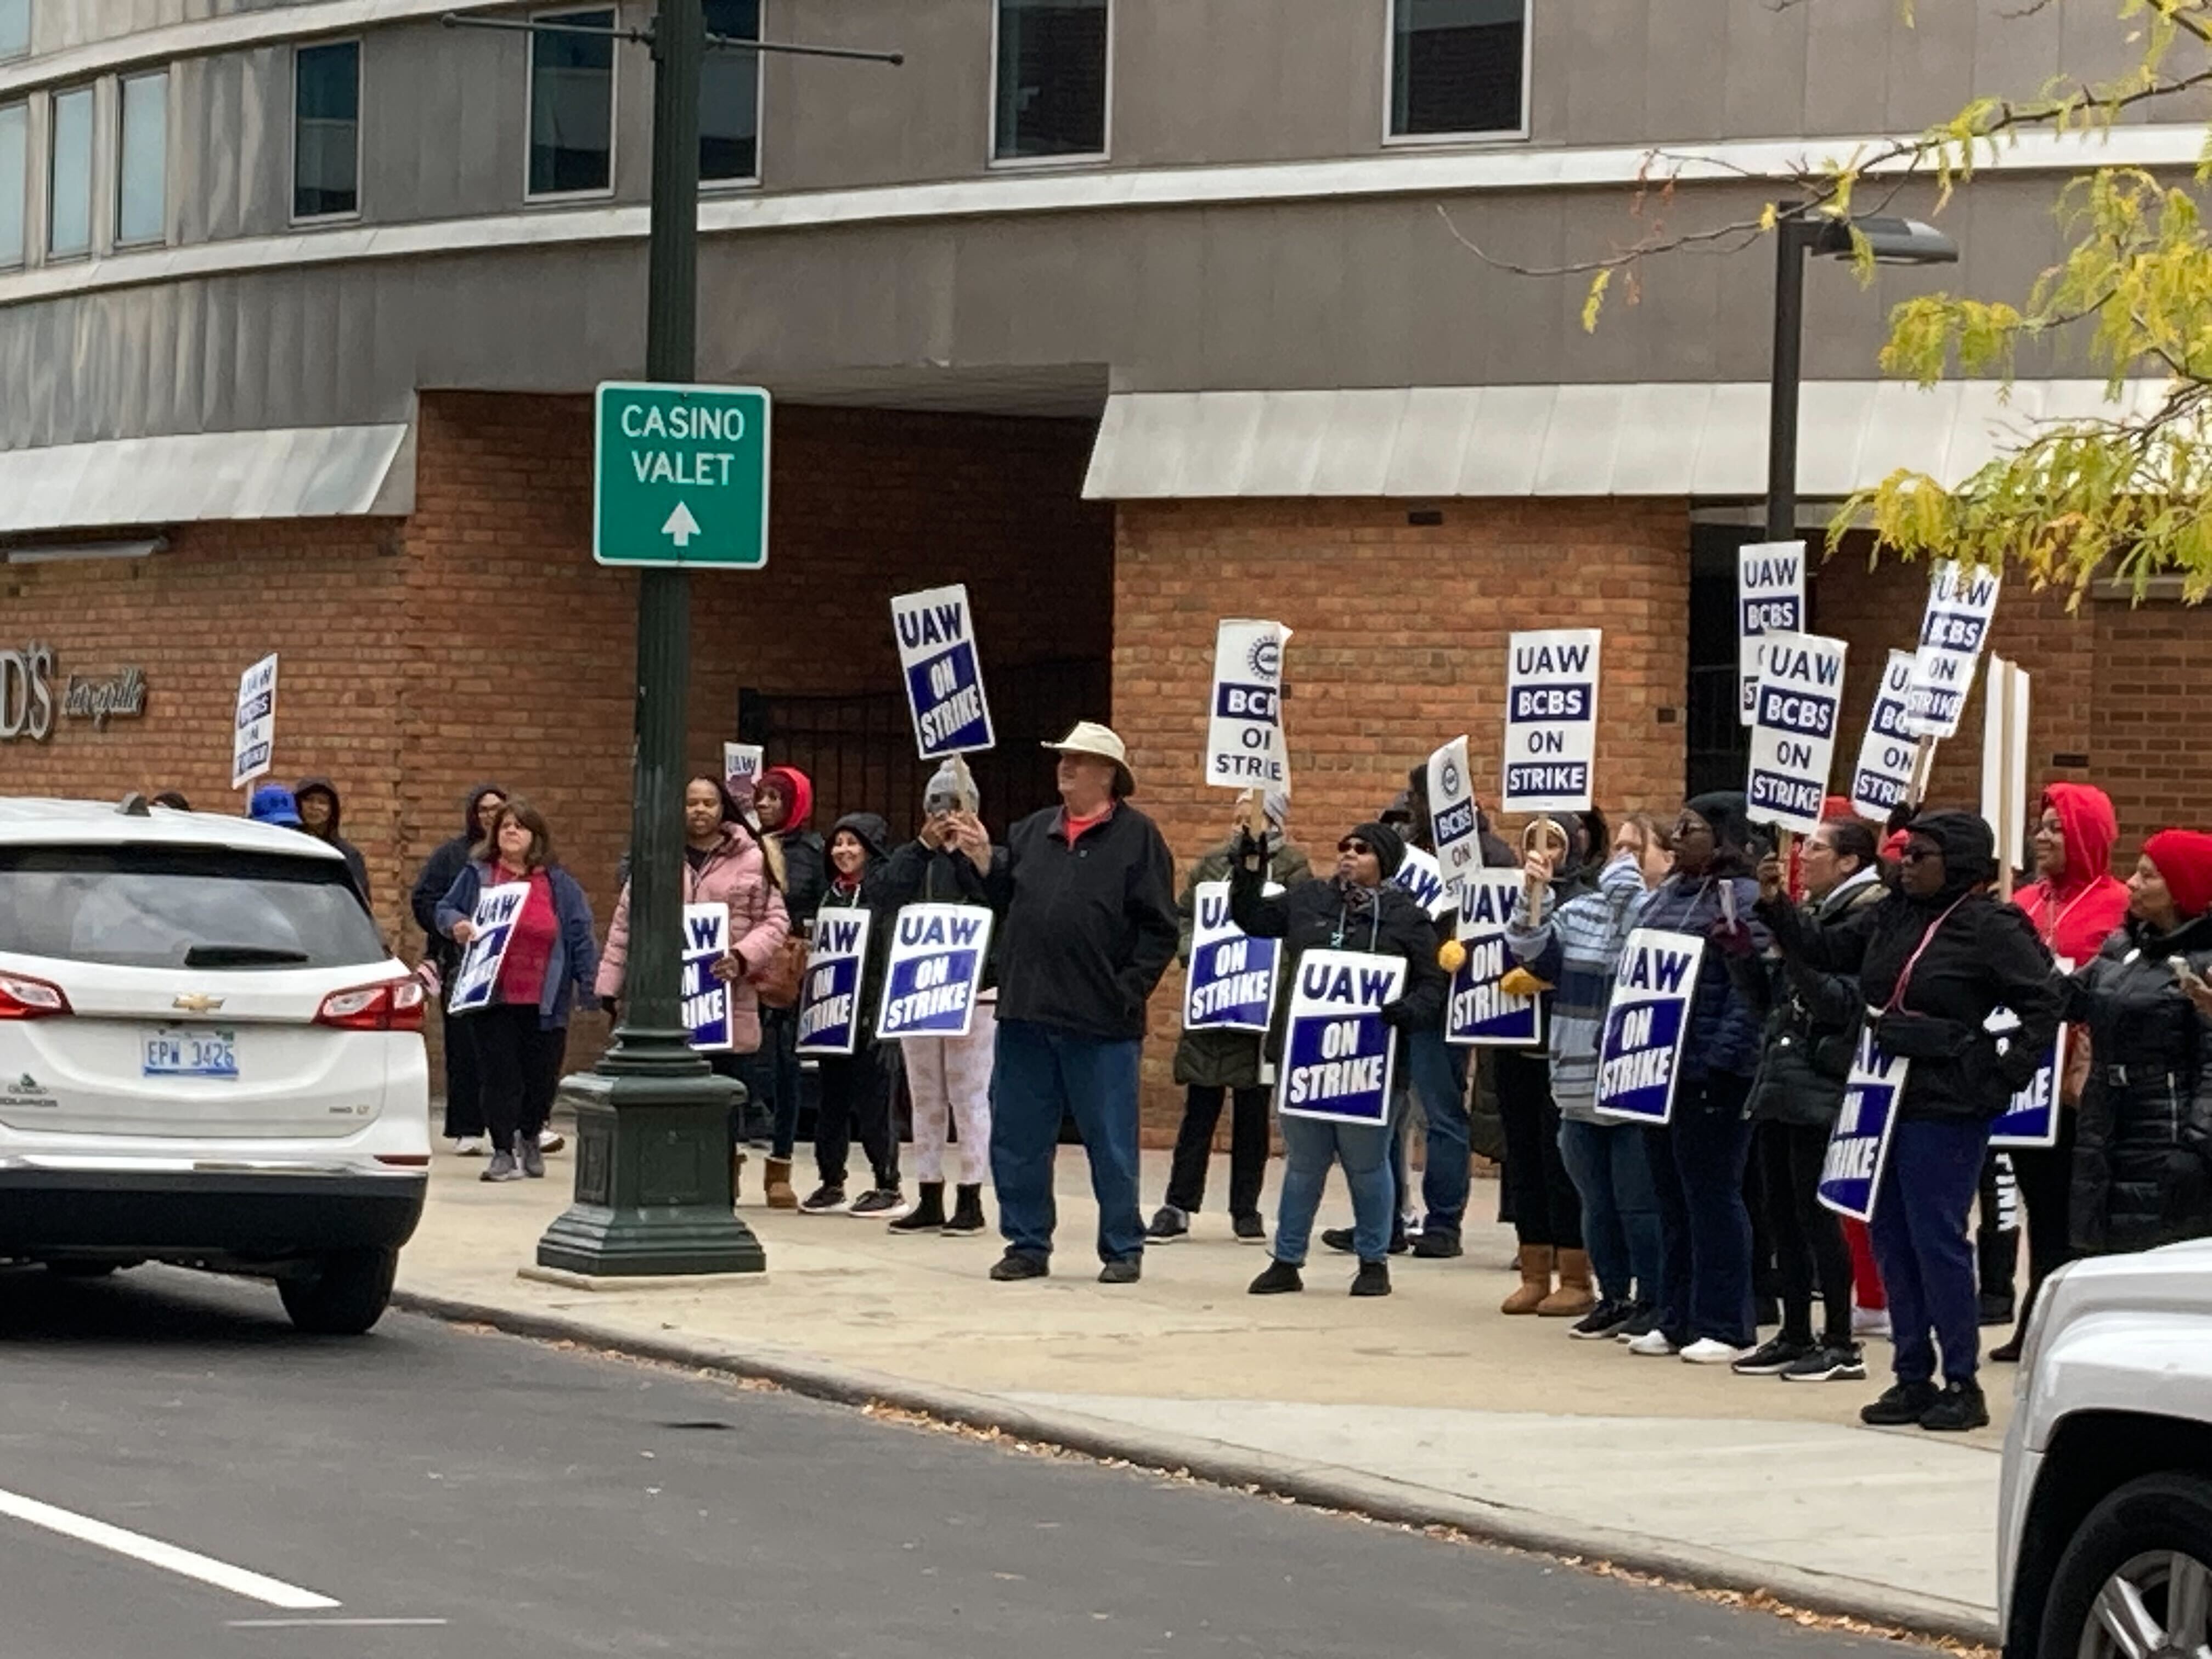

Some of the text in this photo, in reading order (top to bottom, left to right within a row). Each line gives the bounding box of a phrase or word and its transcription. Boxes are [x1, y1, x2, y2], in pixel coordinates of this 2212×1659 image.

[621, 404, 745, 441] CASINO
[631, 450, 735, 486] VALET
[1743, 557, 1798, 588] UAW
[898, 602, 962, 649] UAW
[1747, 602, 1794, 630] BCBS
[930, 655, 957, 700] ON
[1516, 644, 1590, 675] UAW
[1770, 644, 1841, 687] UAW
[1928, 657, 1957, 681] ON
[920, 684, 982, 748] STRIKE
[1518, 689, 1583, 717] BCBS
[1766, 693, 1831, 732] BCBS
[1528, 730, 1564, 754] ON
[1776, 740, 1812, 770] ON
[1509, 766, 1585, 791] STRIKE
[1754, 774, 1821, 813] STRIKE
[1452, 842, 1472, 867] ON
[817, 920, 861, 953] AW
[900, 916, 983, 946] UAW
[915, 955, 950, 990] ON
[1214, 939, 1249, 978] ON
[1472, 939, 1504, 982] ON
[1619, 947, 1693, 994] UAW
[812, 966, 836, 1001] ON
[1191, 970, 1269, 1019] STRIKE
[1303, 963, 1396, 1006] UAW
[887, 980, 970, 1029] STRIKE
[1322, 1020, 1361, 1059] ON
[1622, 1006, 1654, 1051] ON
[1290, 1054, 1384, 1103] STRIKE
[1600, 1045, 1673, 1101] STRIKE
